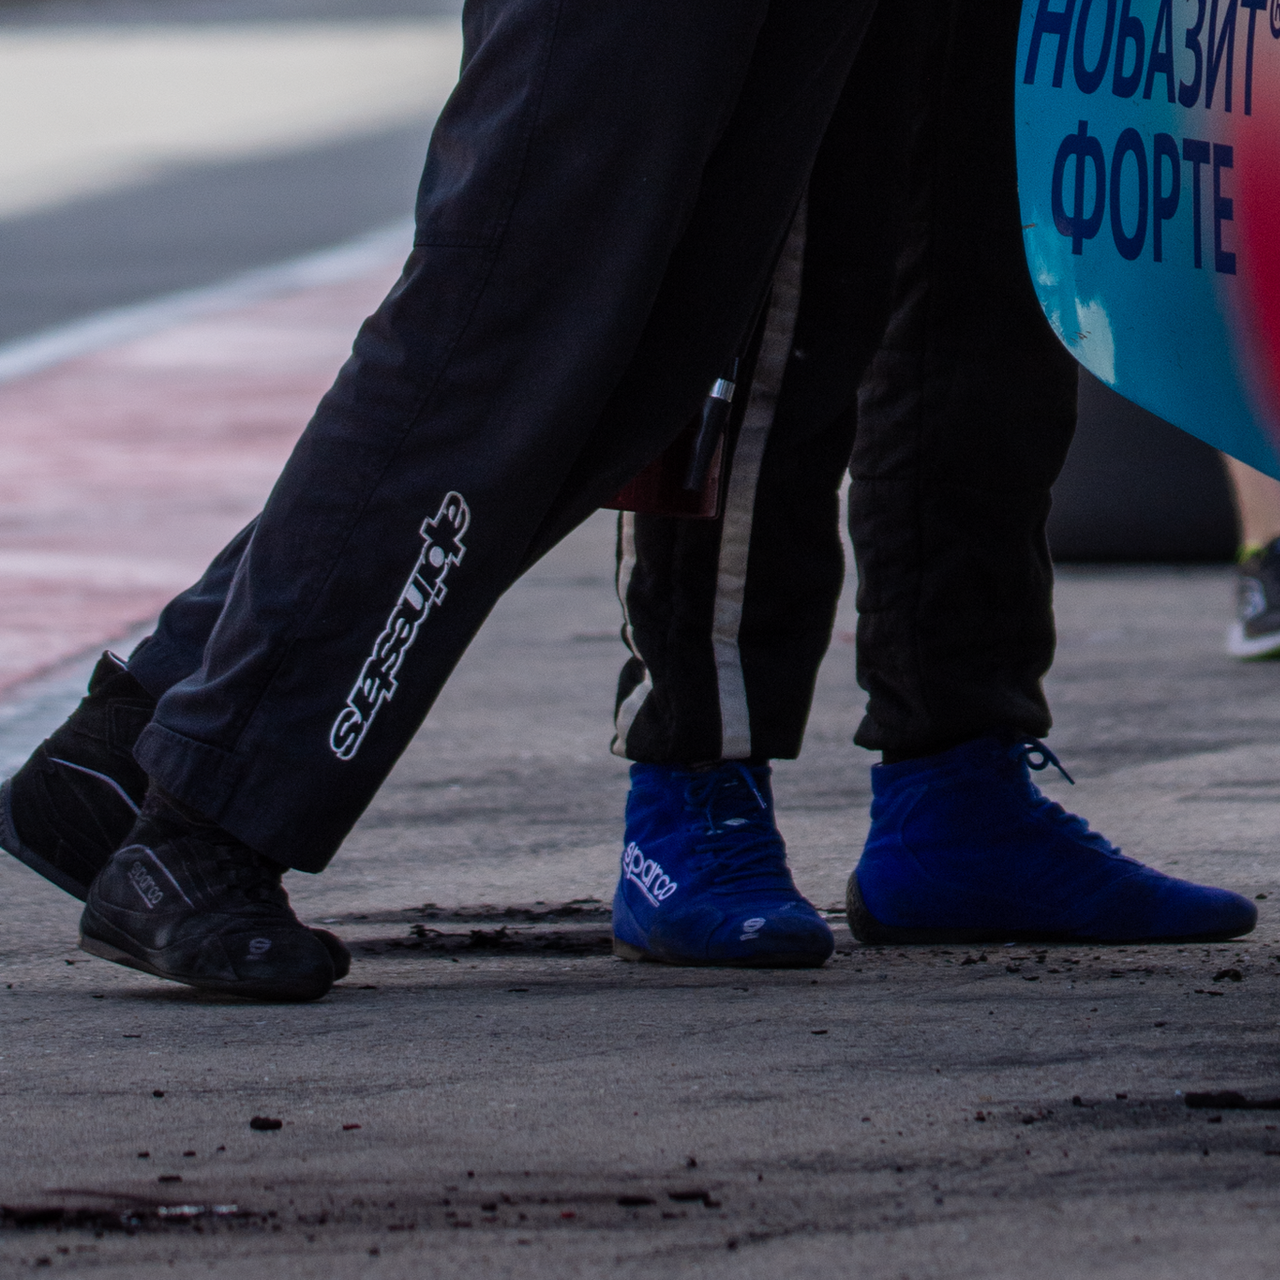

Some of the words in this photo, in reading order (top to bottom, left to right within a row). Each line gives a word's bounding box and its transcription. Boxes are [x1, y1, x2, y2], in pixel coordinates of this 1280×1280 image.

[1051, 119, 1238, 276] ФОРТЕ
[129, 861, 164, 906] sparco
[623, 842, 678, 904] sparco
